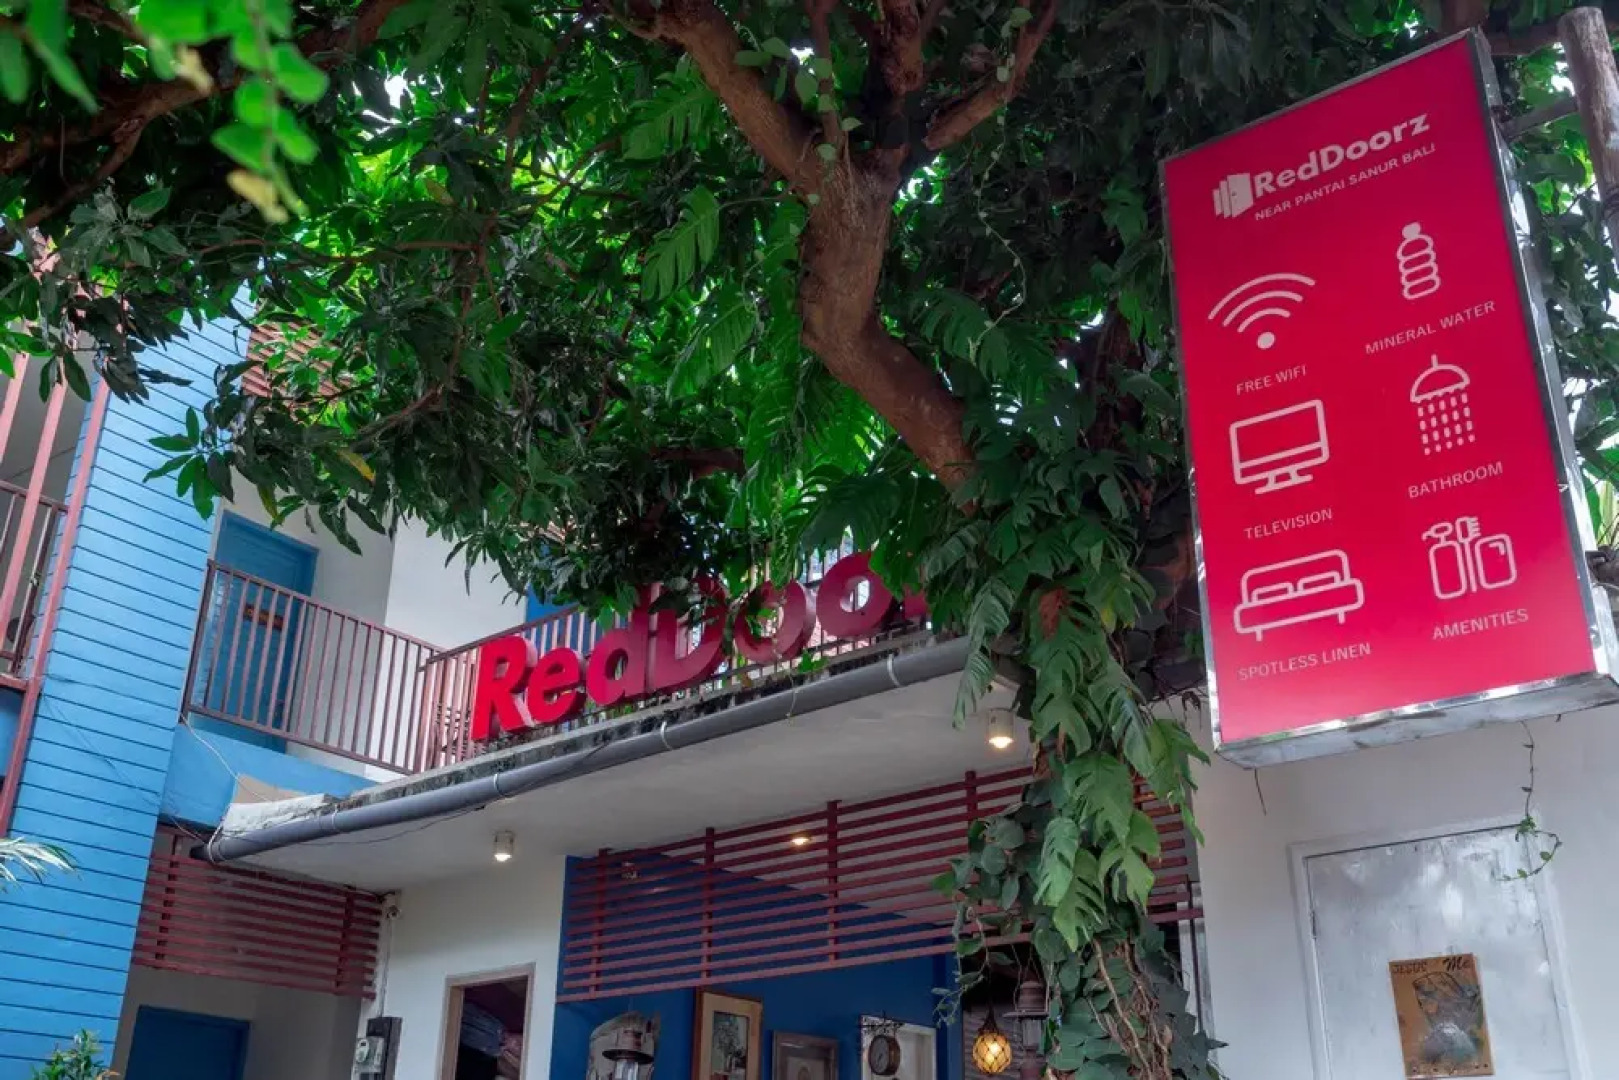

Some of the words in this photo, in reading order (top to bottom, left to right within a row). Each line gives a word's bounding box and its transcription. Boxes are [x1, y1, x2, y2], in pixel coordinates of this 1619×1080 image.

[1253, 112, 1431, 199] RedDoorz
[1254, 200, 1292, 221] NEAR
[1294, 178, 1346, 207] PANTAI
[1348, 157, 1399, 186] SANUR
[1401, 141, 1436, 165] BALI
[1364, 324, 1437, 356] MINERAL
[1439, 300, 1496, 330] WATER
[1236, 376, 1272, 396] FREE
[1274, 364, 1307, 386] WIFI
[1407, 461, 1504, 500] BATHROOM
[1243, 507, 1333, 540] TELEVISION
[1432, 608, 1529, 641] AMENITIES
[471, 550, 930, 741] RedDoo
[1238, 653, 1319, 682] SPOTLESS
[1321, 641, 1372, 666] LINEN
